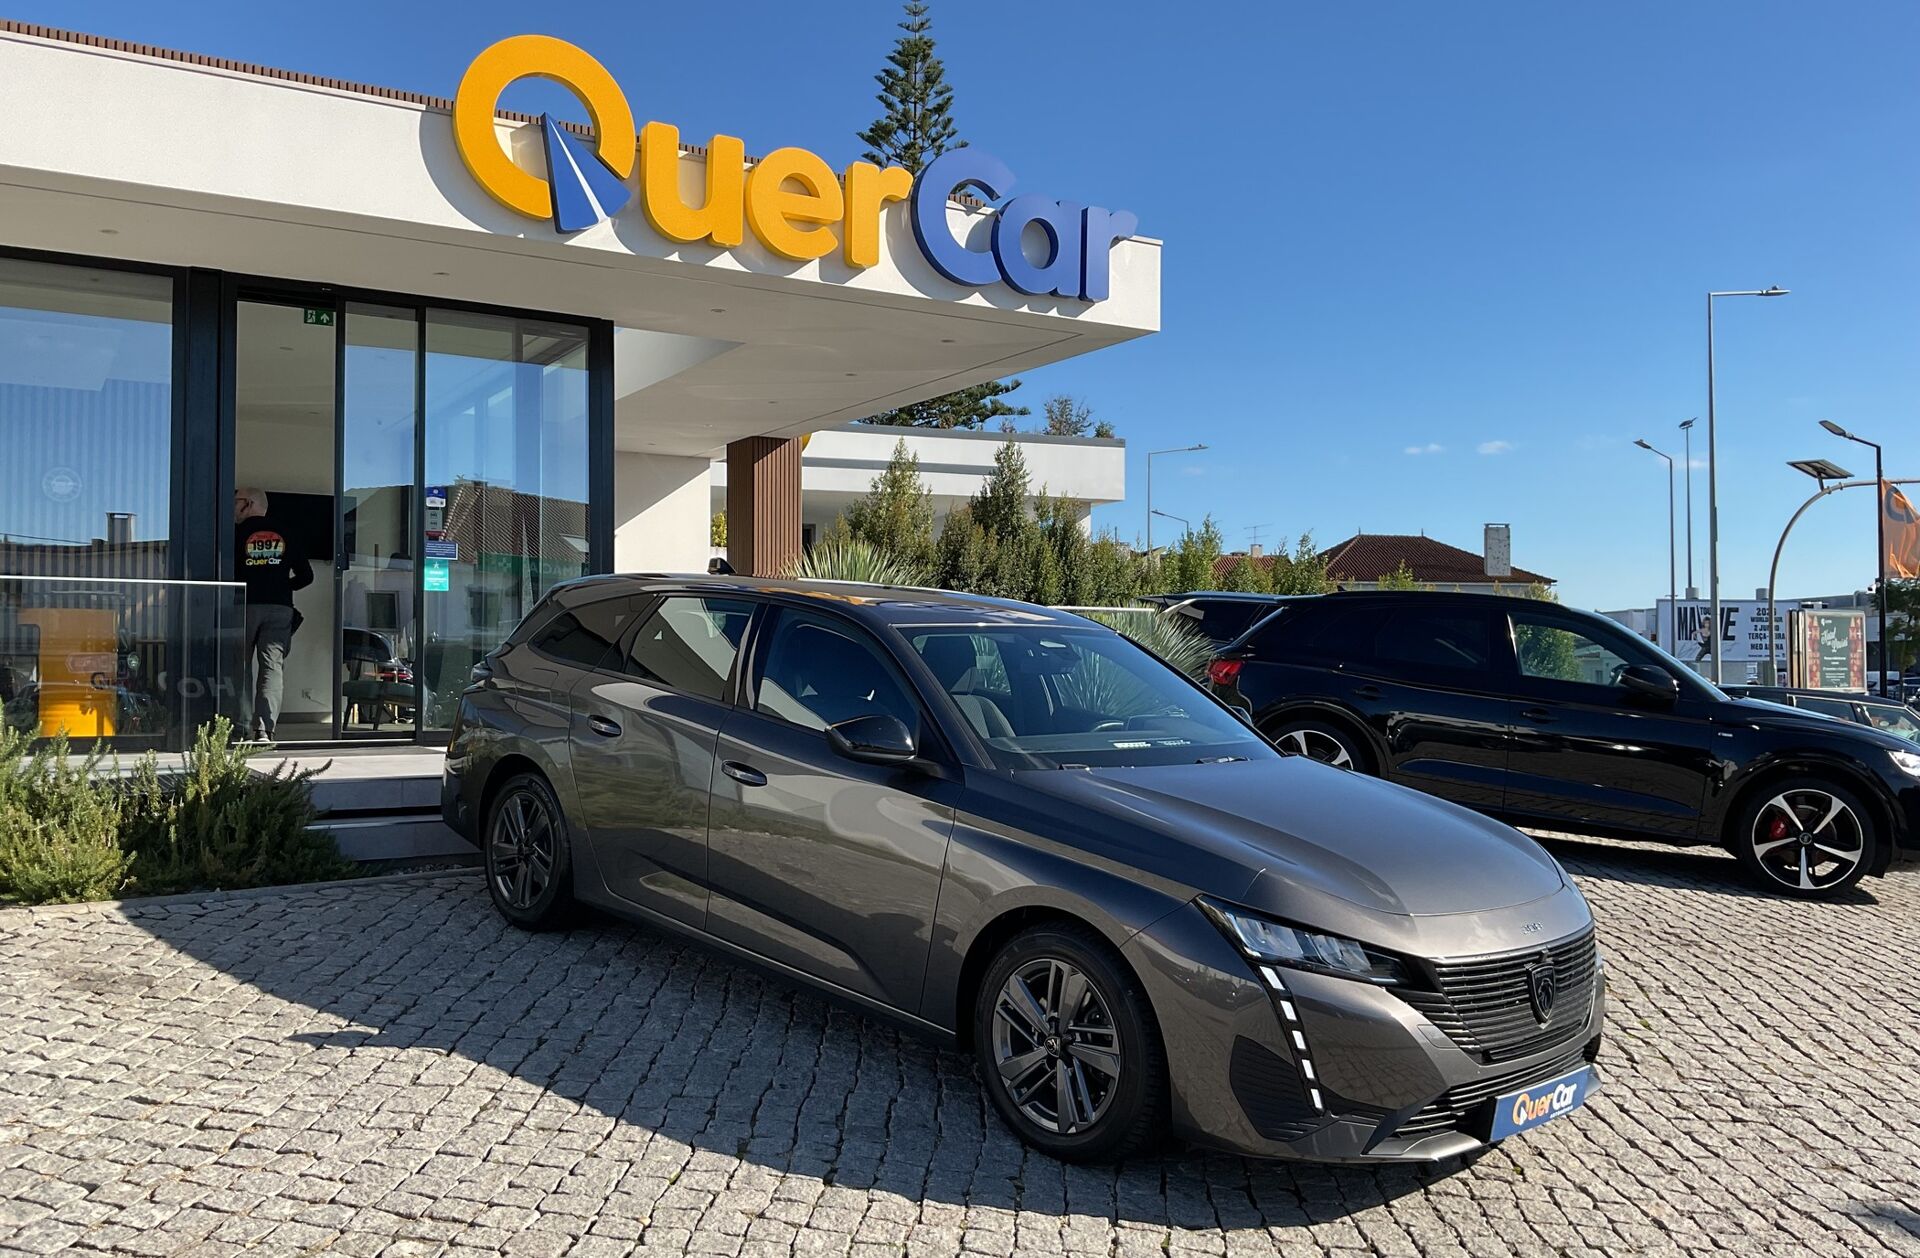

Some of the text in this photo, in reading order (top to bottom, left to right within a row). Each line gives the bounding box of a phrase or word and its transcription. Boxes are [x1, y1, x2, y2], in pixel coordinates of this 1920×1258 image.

[453, 34, 1137, 300] QuerCar
[251, 538, 281, 551] 1997
[245, 557, 282, 566] QuerCar
[1513, 1083, 1577, 1126] QuerCar
